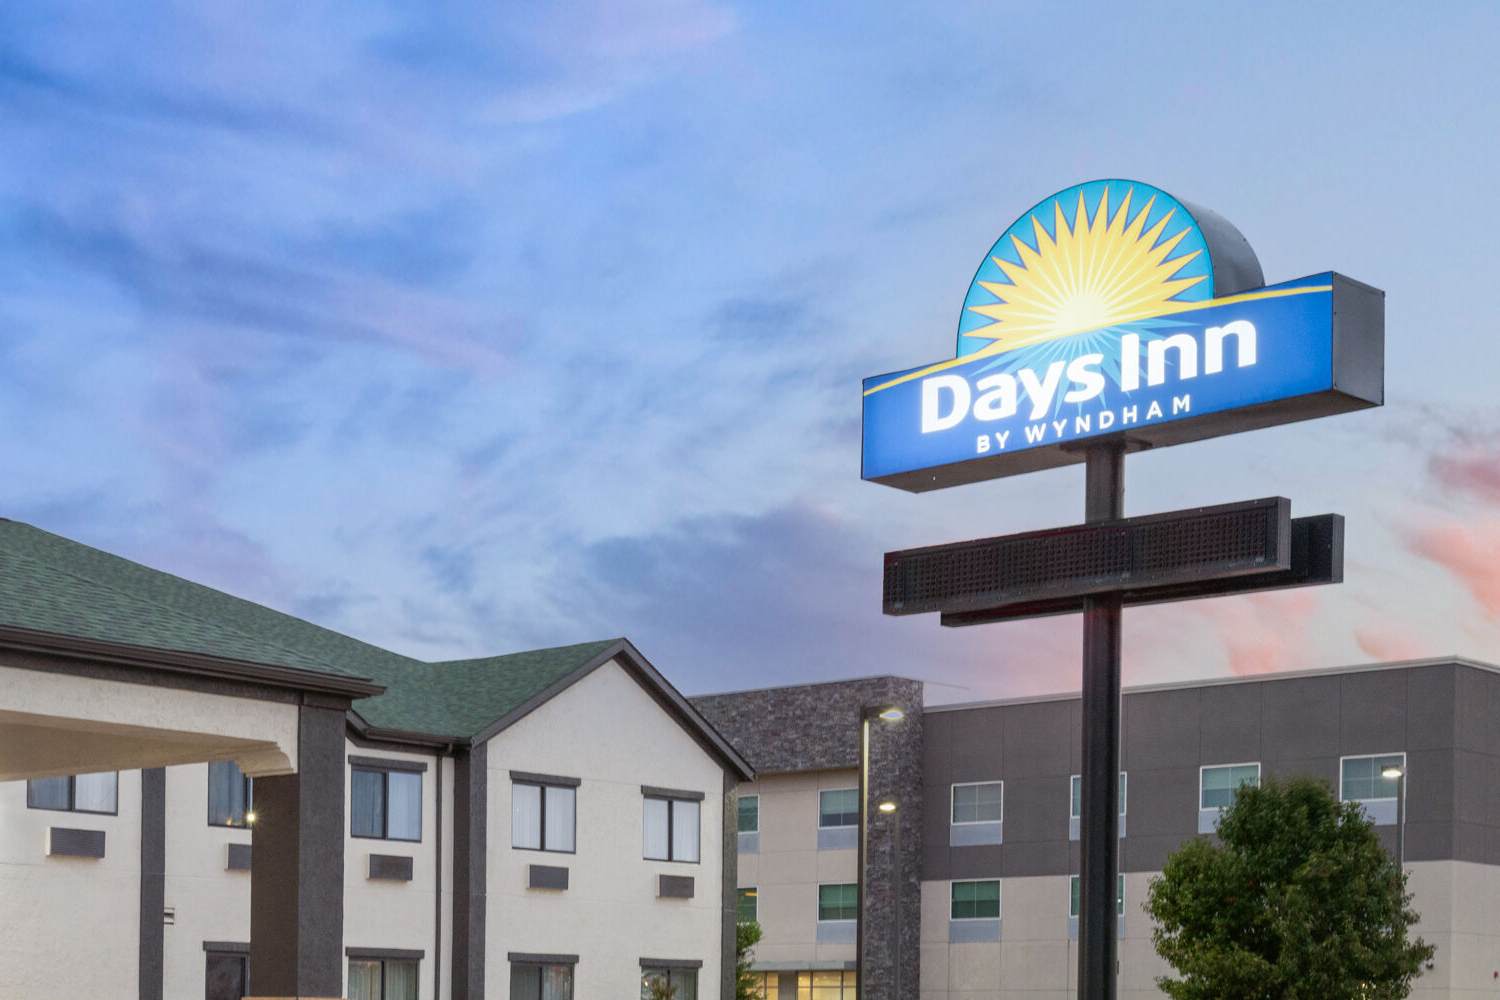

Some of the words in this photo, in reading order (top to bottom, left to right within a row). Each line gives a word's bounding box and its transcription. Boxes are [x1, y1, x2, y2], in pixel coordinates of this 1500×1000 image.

[921, 353, 1106, 434] Days
[1120, 319, 1257, 393] Inn
[976, 431, 1010, 454] BY
[1024, 394, 1190, 444] WYNDHAM
